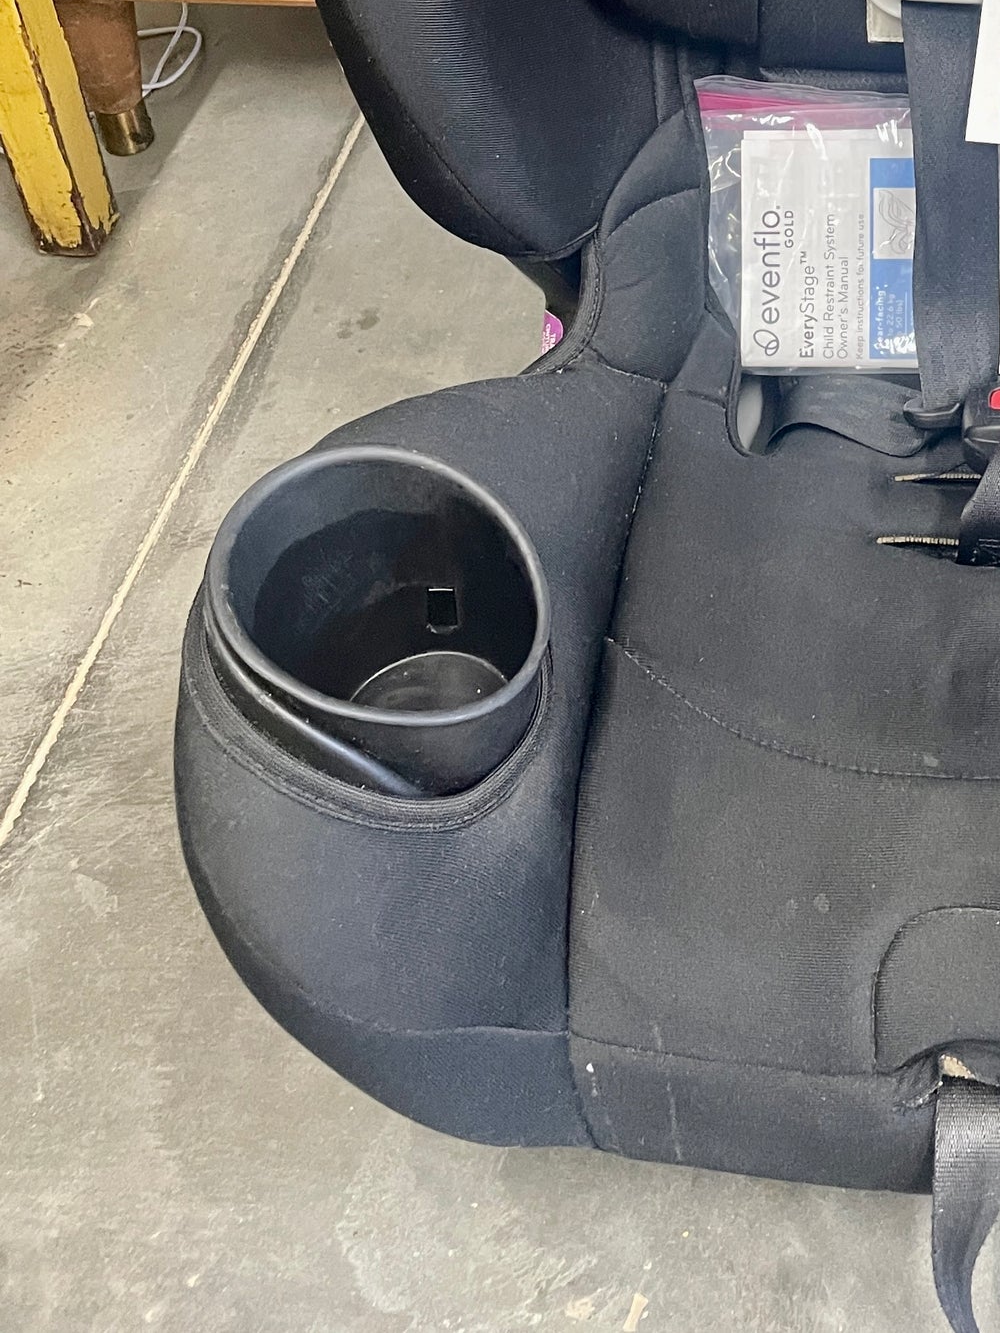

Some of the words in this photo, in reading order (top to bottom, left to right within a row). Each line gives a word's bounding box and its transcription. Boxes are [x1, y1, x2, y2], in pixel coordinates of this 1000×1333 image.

[784, 210, 794, 248] GOLD
[823, 214, 839, 260] System
[855, 234, 865, 261] future
[823, 265, 835, 321] Restraint
[838, 256, 849, 303] Manual
[856, 278, 865, 333] instructions
[875, 290, 886, 348] ear-facing
[823, 327, 835, 360] Child
[837, 308, 849, 359] Owner's
[856, 336, 865, 360] Keep
